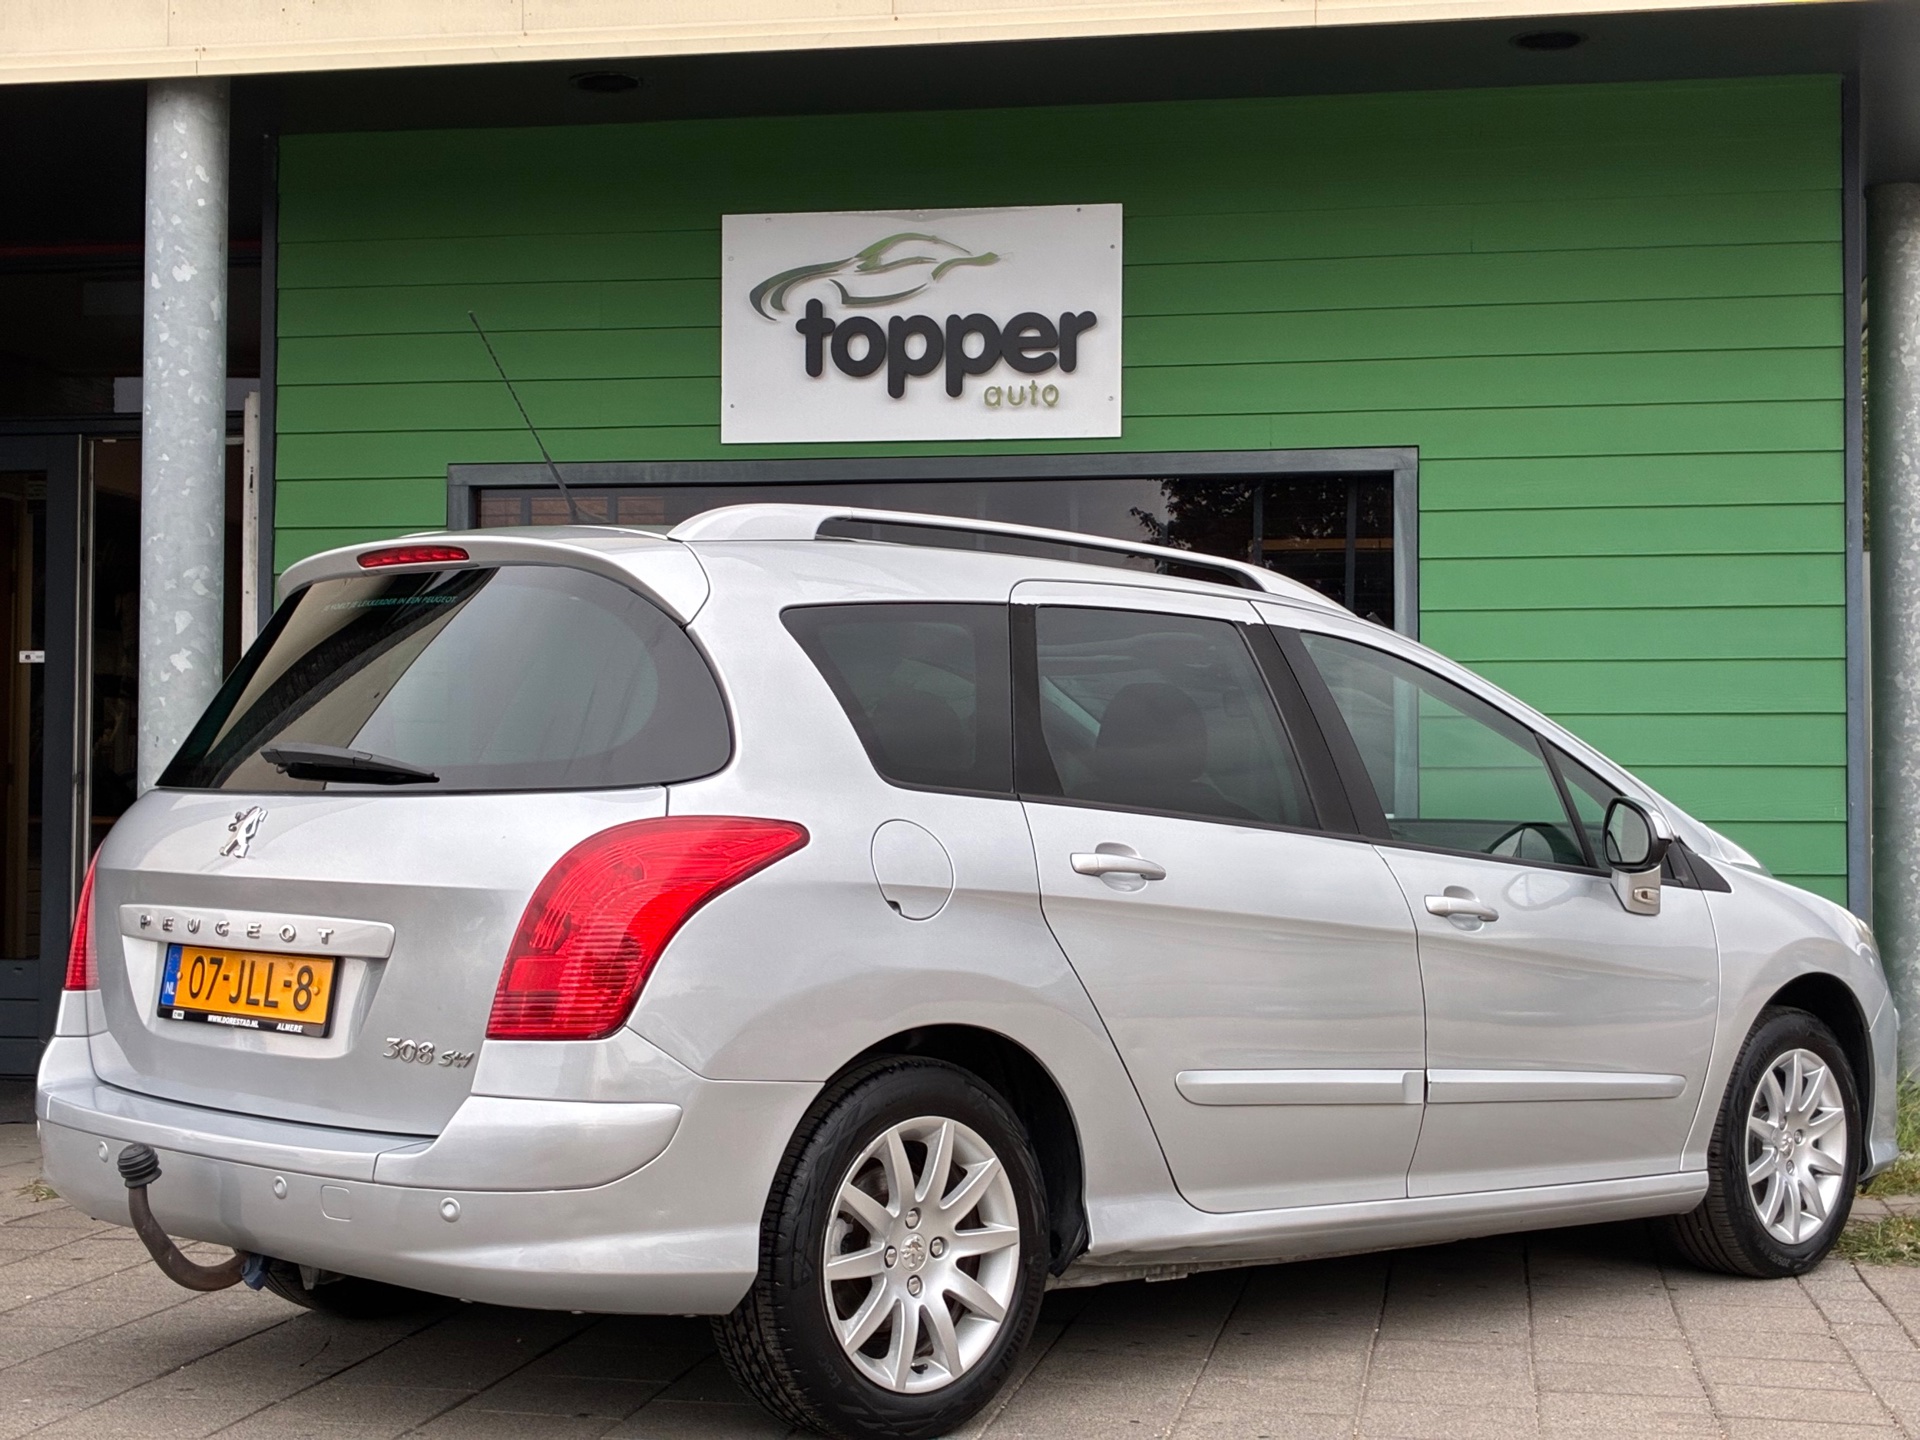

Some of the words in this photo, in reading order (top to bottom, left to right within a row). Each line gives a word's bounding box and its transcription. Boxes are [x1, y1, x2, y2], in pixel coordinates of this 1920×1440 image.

[795, 298, 1097, 399] topper
[983, 380, 1060, 407] auto
[140, 914, 335, 944] PEUGEOT
[164, 981, 175, 995] NL
[188, 955, 315, 1012] 07-JLL-8
[276, 1022, 304, 1033] ALMERE
[383, 1037, 436, 1066] 308
